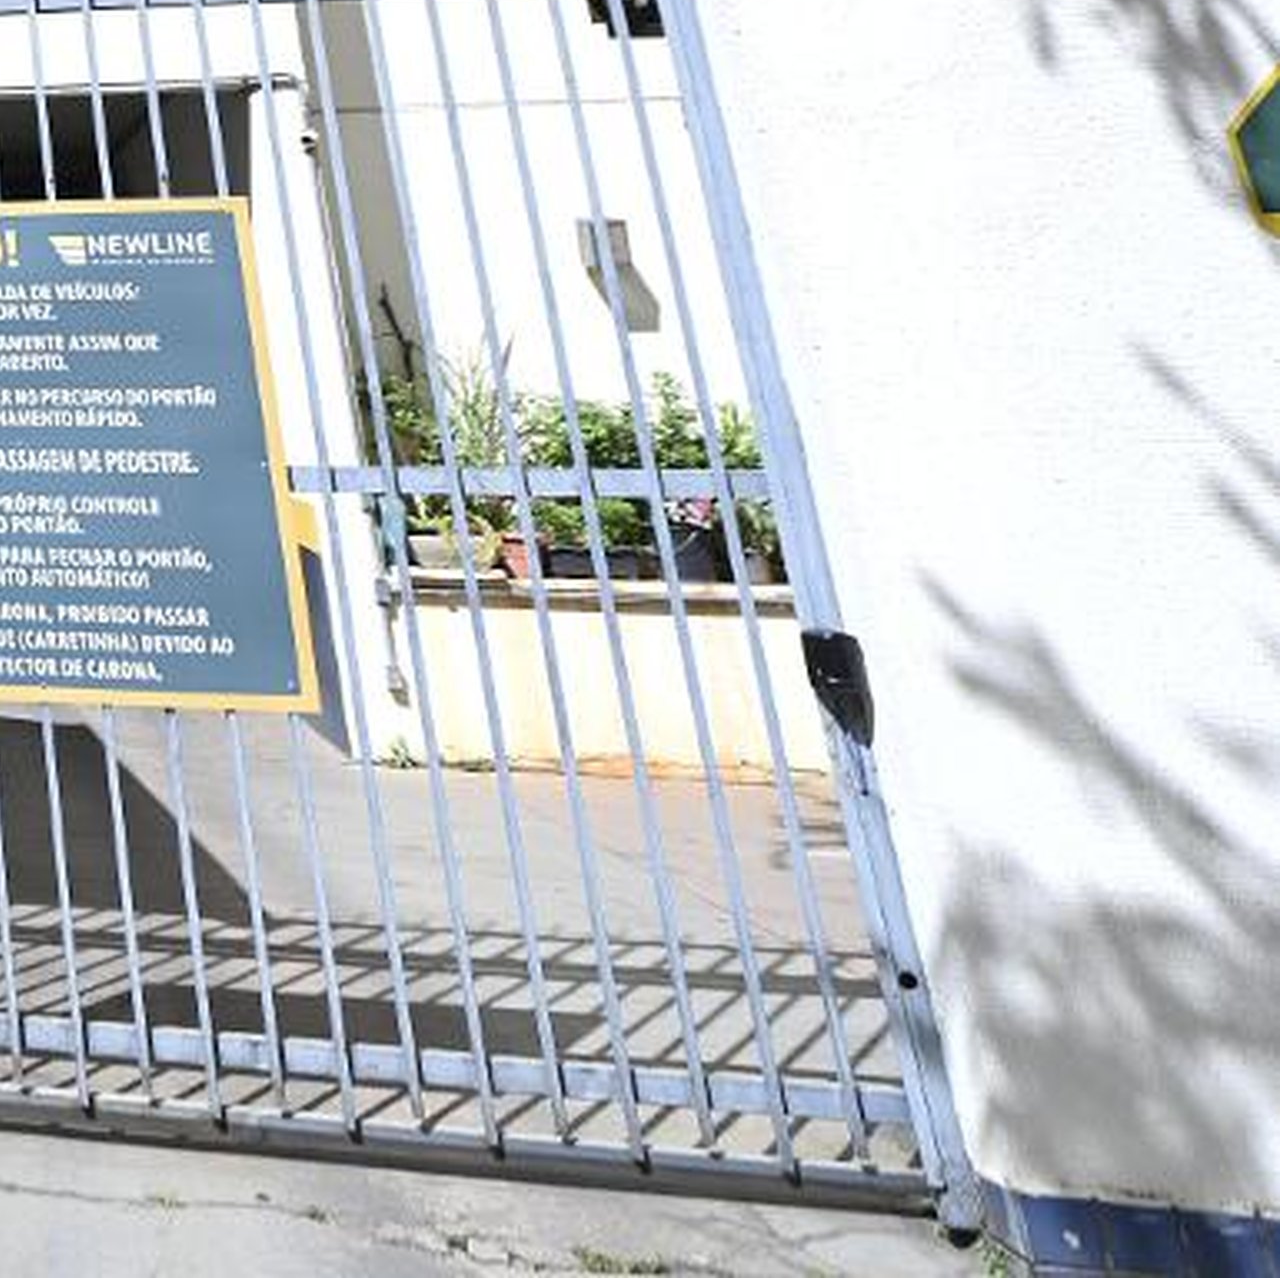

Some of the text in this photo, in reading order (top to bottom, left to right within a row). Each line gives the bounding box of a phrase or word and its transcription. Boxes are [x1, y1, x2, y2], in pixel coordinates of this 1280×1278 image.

[88, 231, 215, 256] NEWLINE
[31, 283, 52, 300] DE
[68, 334, 122, 352] ASSIM
[124, 334, 162, 352] QUE
[15, 388, 39, 406] NO
[41, 388, 124, 406] PERCURSO
[125, 388, 149, 406] DO
[151, 385, 218, 407] PORTÃO
[78, 449, 103, 472] DE
[104, 449, 200, 473] PEDESTRE.
[70, 495, 160, 516] CONTROLE
[48, 548, 117, 567] FECHAR
[118, 549, 133, 567] O
[134, 546, 214, 572] PORTÃO,
[57, 604, 141, 623] PROIBIDO
[143, 607, 210, 627] PASSAR
[141, 634, 207, 654] DEVIDO
[210, 636, 235, 656] AO
[60, 658, 85, 678] DE
